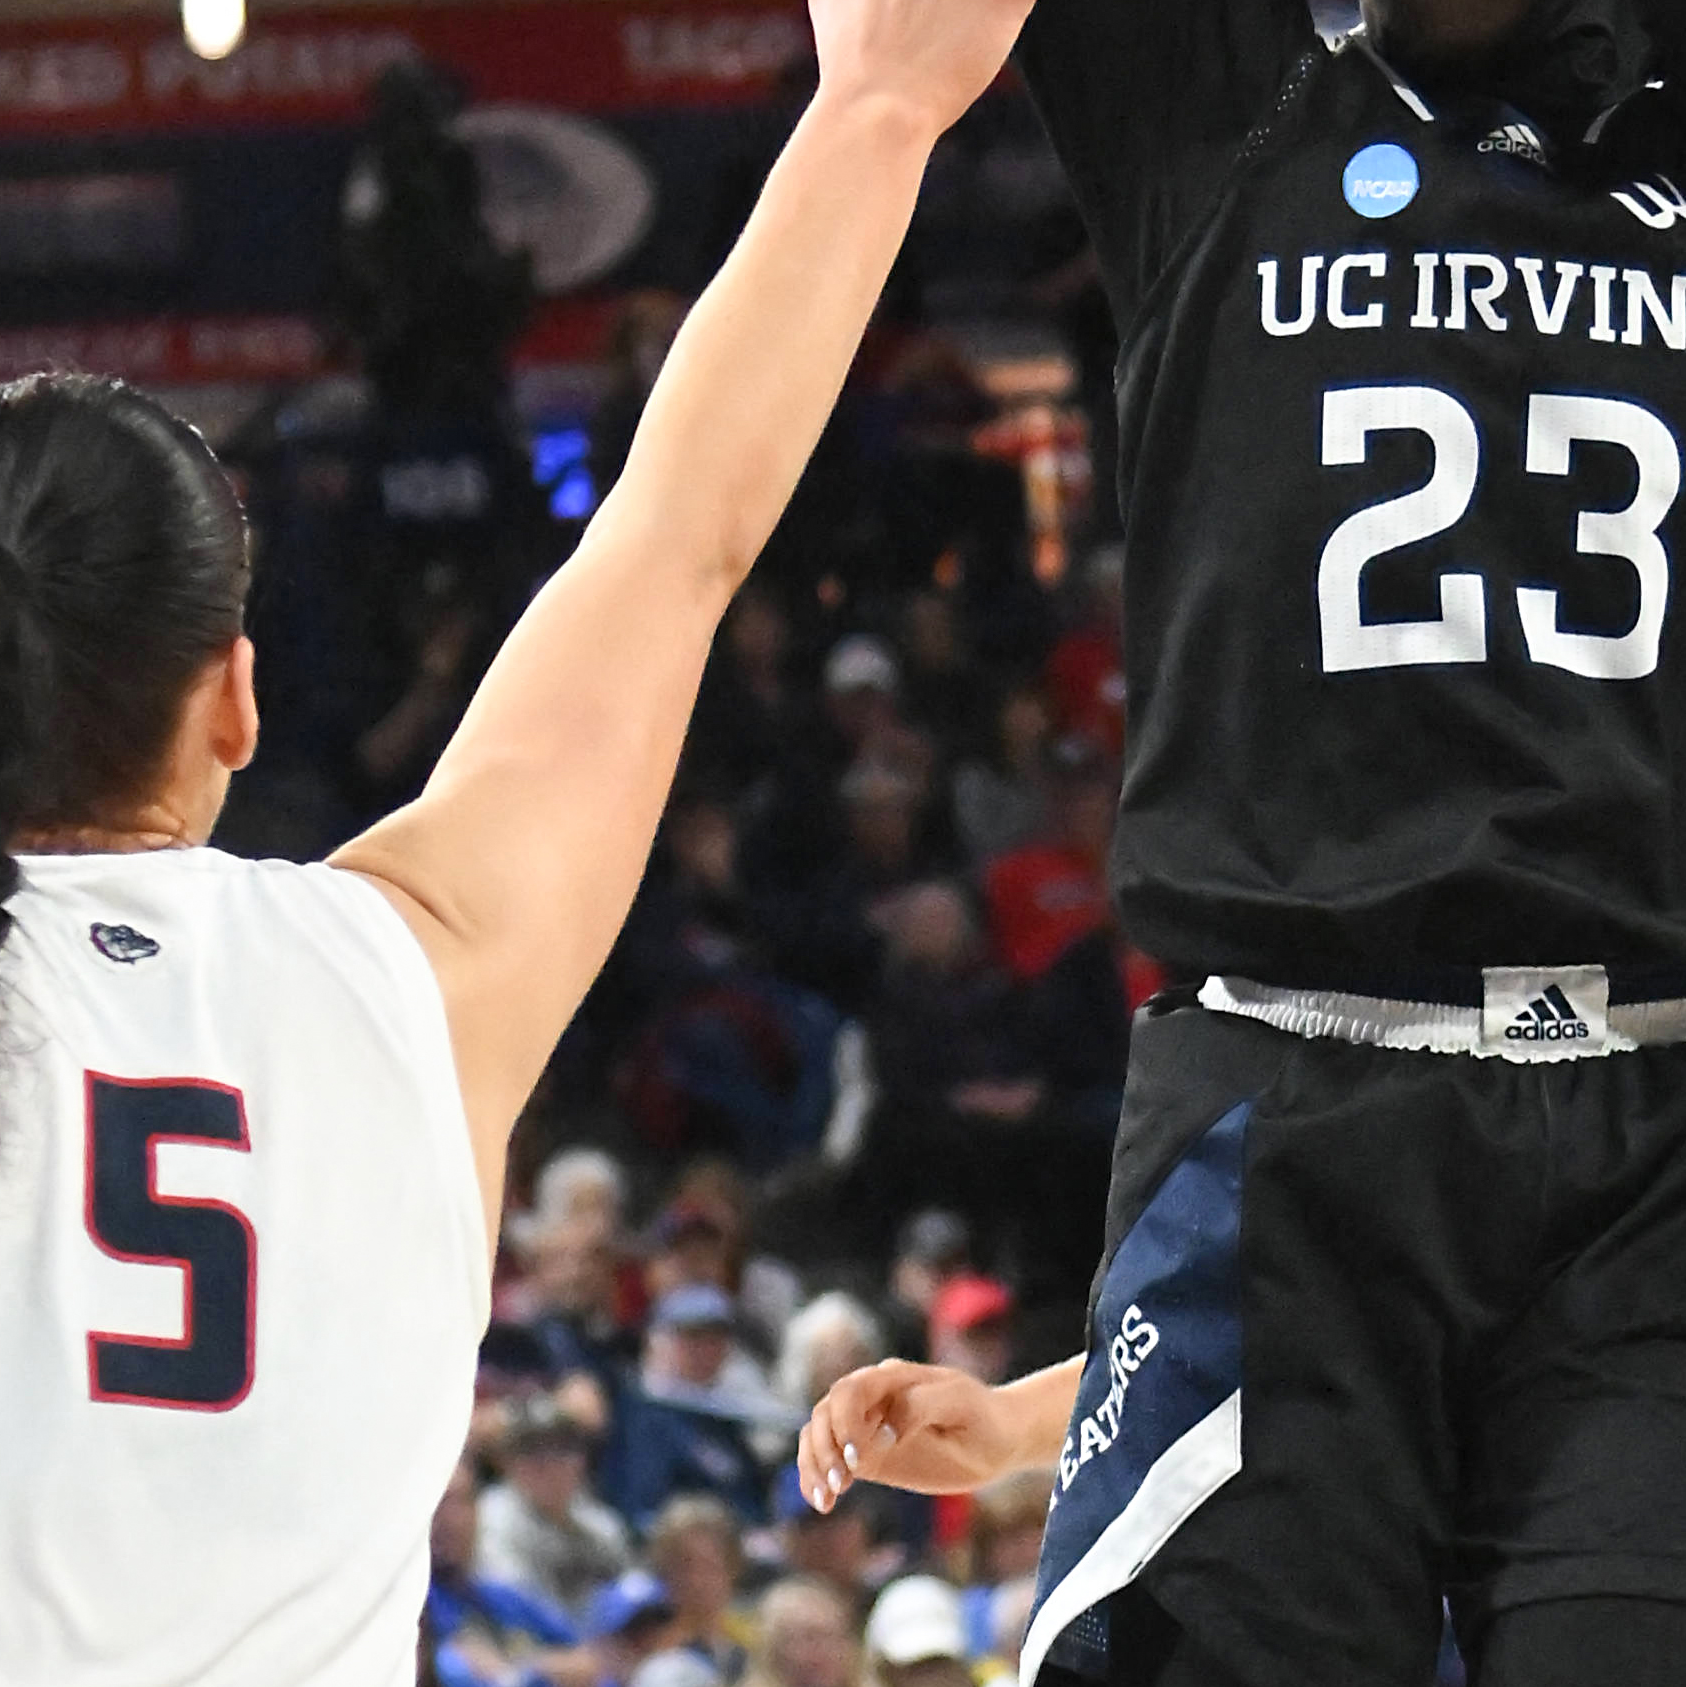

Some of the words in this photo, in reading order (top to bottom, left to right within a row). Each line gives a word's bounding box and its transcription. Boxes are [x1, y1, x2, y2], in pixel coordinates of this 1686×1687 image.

[1476, 138, 1548, 164] adida
[1353, 178, 1414, 200] NCAA
[1257, 253, 1387, 337] UC
[1317, 385, 1681, 680] 23
[1504, 1014, 1589, 1042] adidas
[84, 1069, 258, 1414] 5
